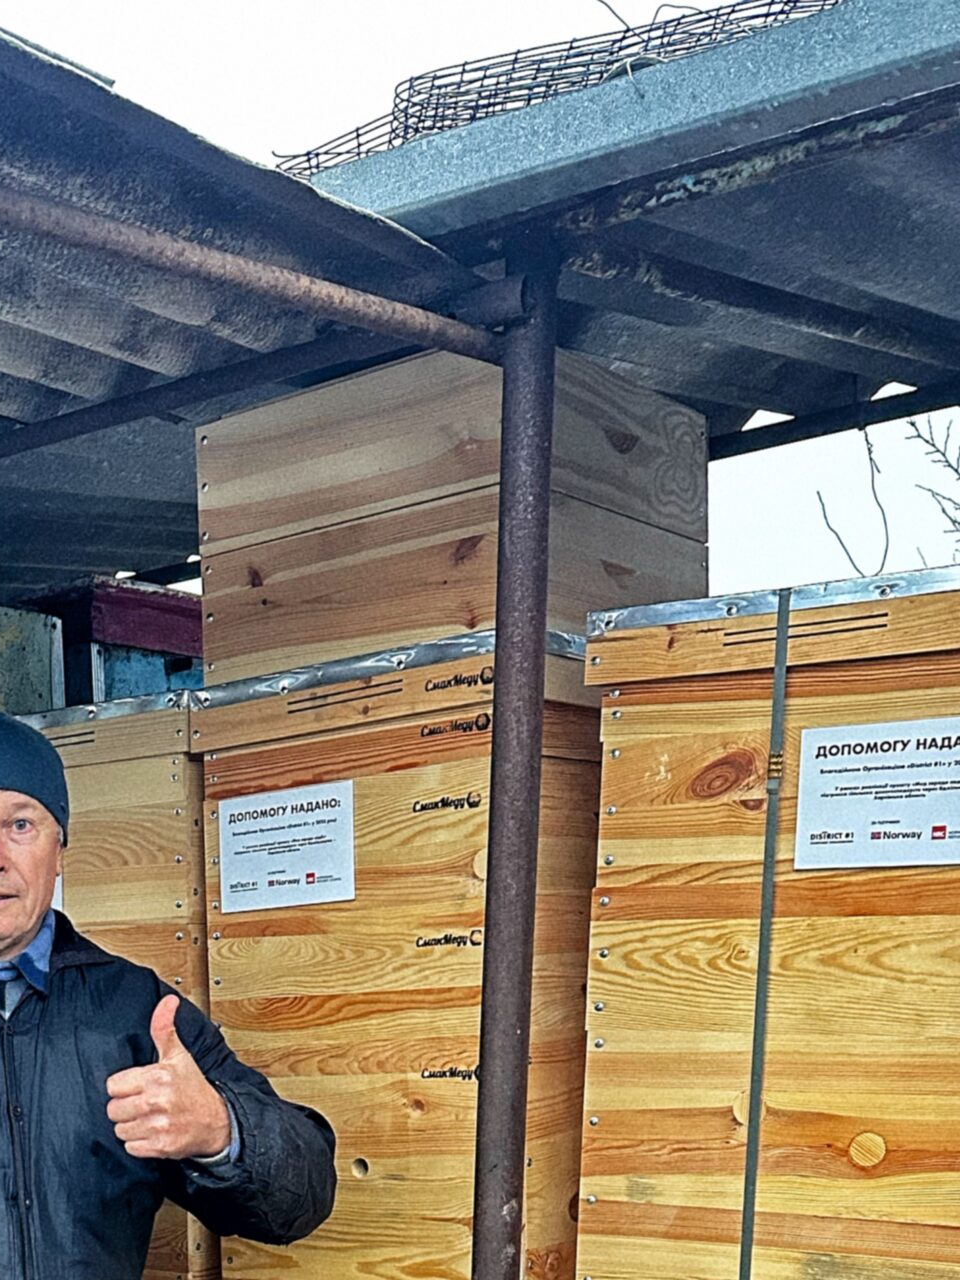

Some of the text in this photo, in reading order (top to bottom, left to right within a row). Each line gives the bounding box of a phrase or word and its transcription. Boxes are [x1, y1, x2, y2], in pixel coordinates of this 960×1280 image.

[815, 736, 960, 759] ДОПОМОГУ НАДА
[228, 798, 341, 825] ДОПОМОГУ НАДАНО:
[883, 831, 922, 840] Norway
